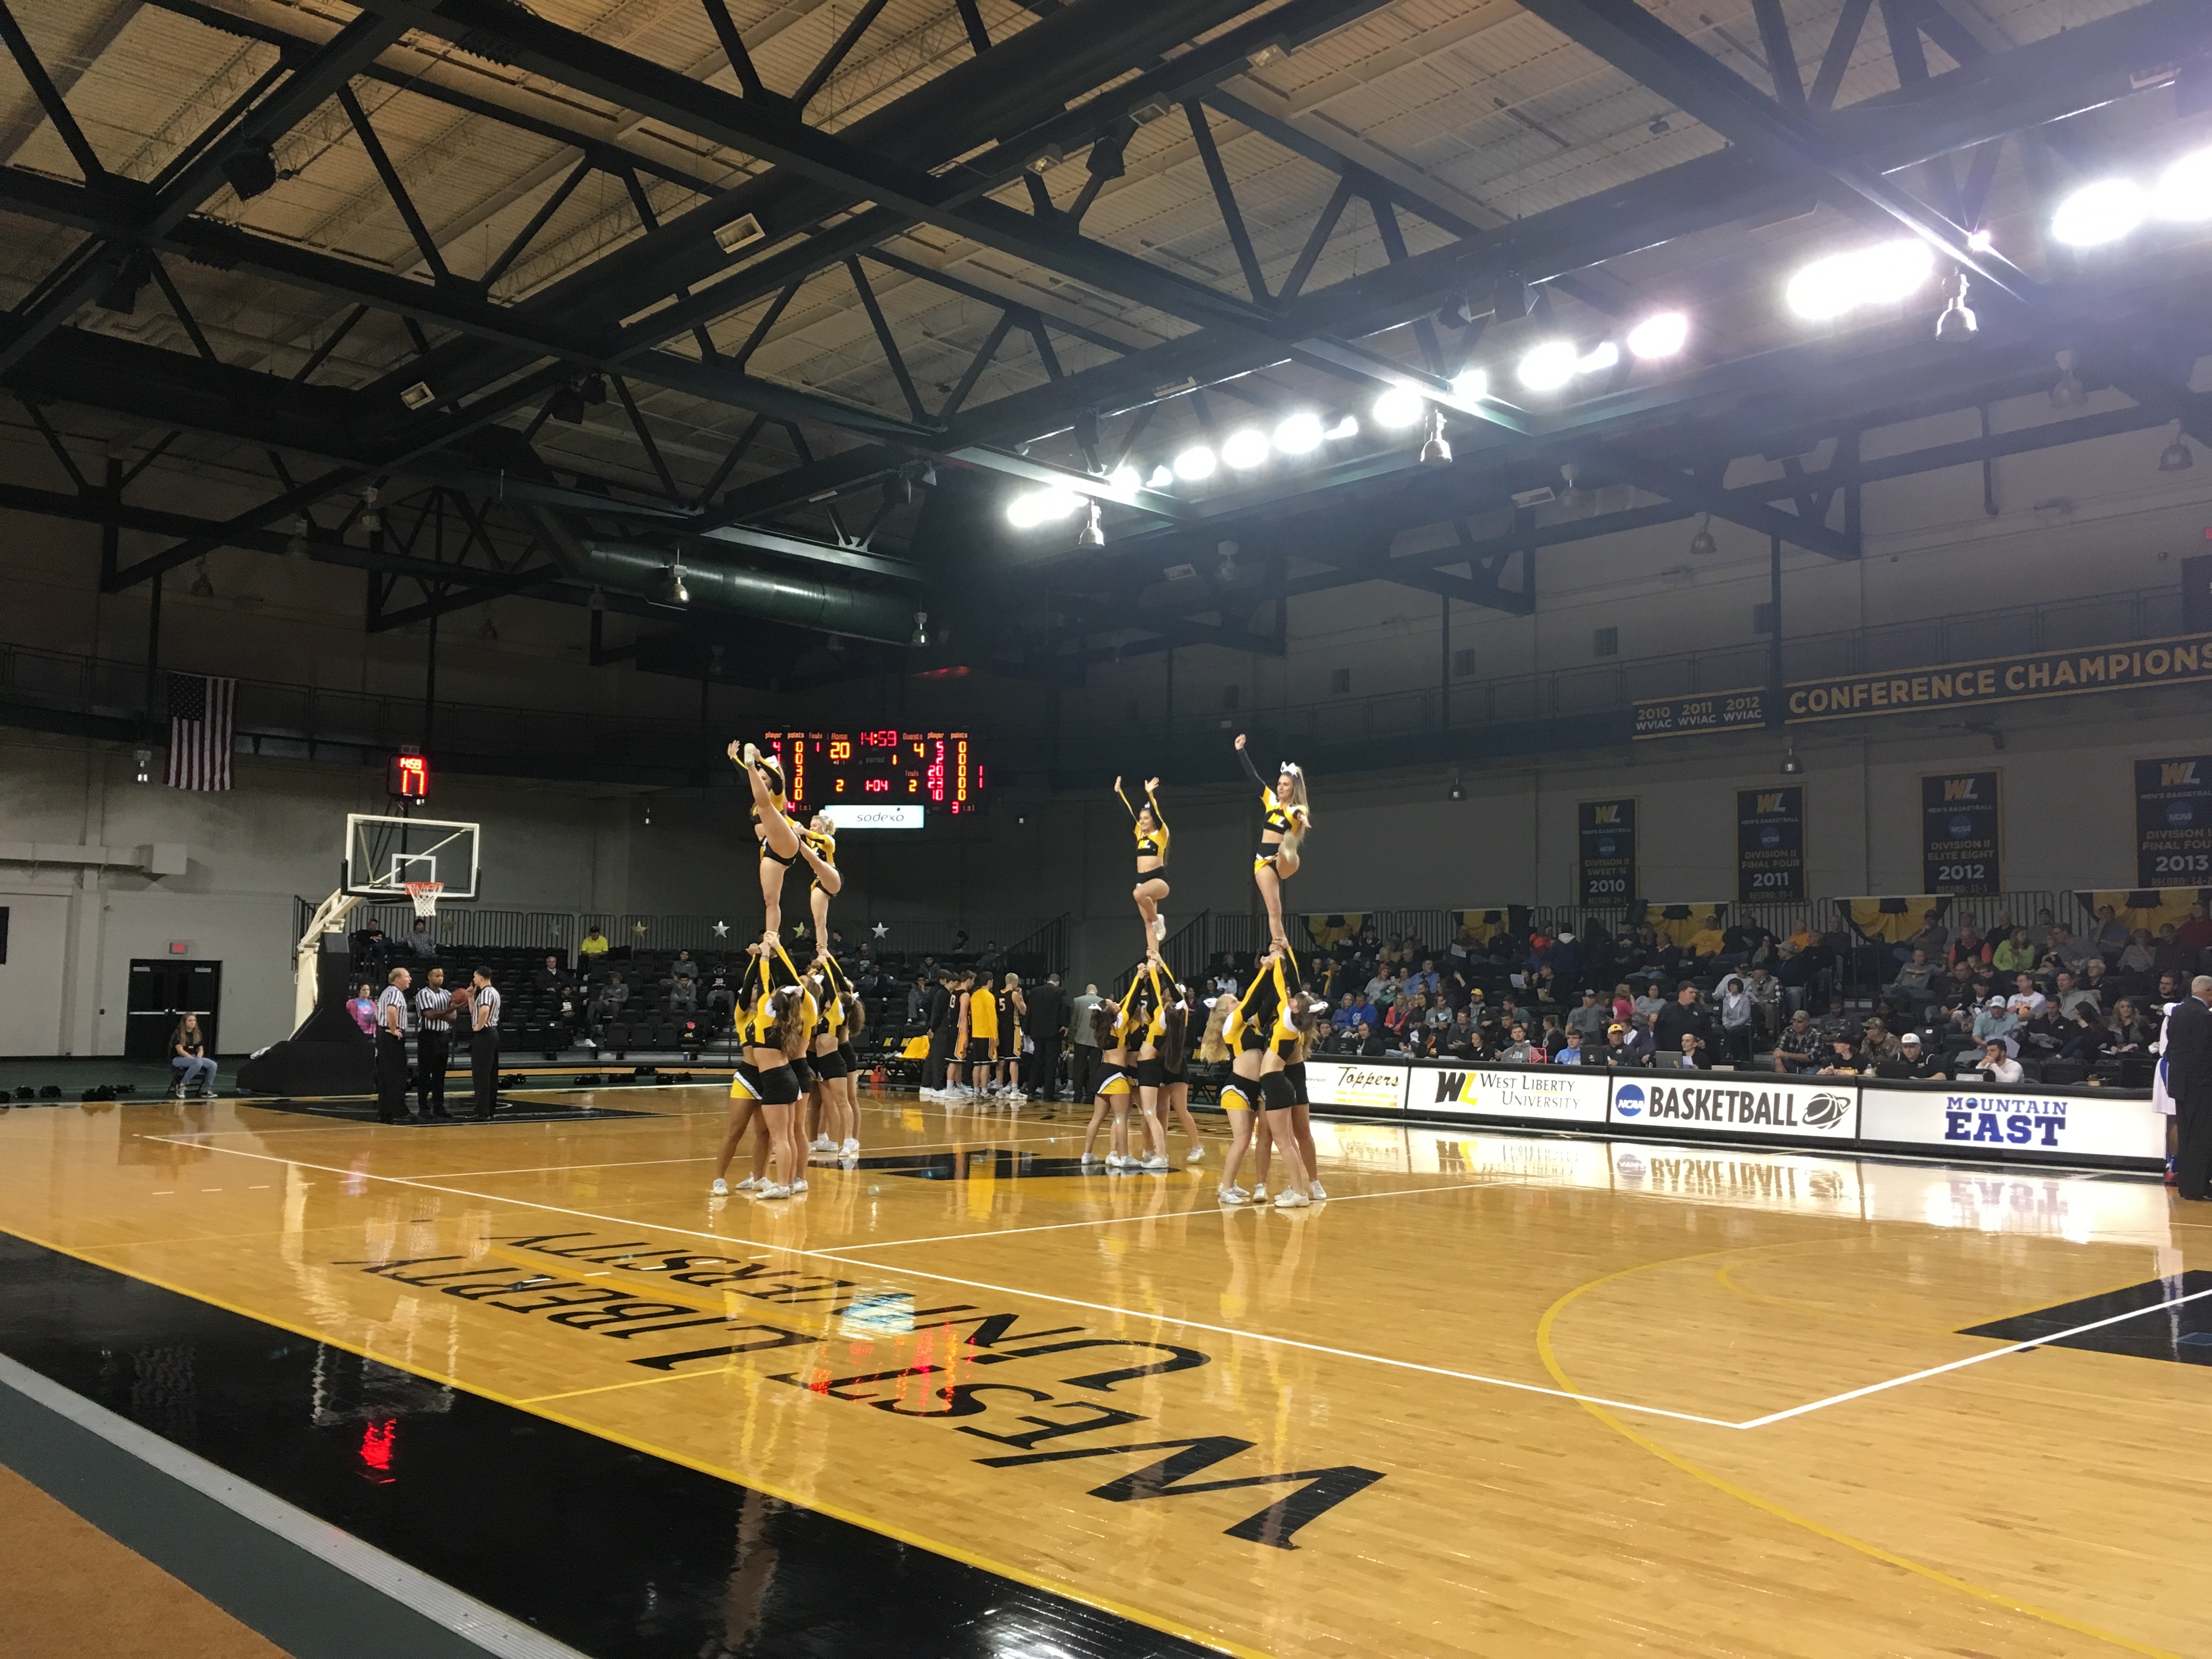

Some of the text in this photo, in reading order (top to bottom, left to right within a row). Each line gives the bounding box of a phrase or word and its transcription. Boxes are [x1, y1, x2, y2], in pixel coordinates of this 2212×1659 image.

[1789, 669, 1995, 714] CONFERENCE
[1681, 702, 1713, 716] 2011
[1725, 696, 1760, 710] 2012
[1638, 707, 1671, 720] 2010
[1678, 714, 1717, 726] WVIAC
[1723, 709, 1762, 722] WVIAC
[1635, 719, 1673, 731] WVIAC
[860, 731, 898, 747] 14:59
[795, 741, 803, 752] 0
[830, 742, 850, 759] 20
[913, 742, 925, 758] 4
[958, 741, 967, 753] 0
[795, 753, 803, 764] 0
[892, 754, 897, 765] 1
[958, 753, 967, 764] 0
[958, 765, 967, 777] 0
[2160, 761, 2200, 786] WL
[402, 770, 424, 795] 17
[794, 777, 803, 788] 0
[835, 778, 845, 792] 2
[908, 779, 918, 792] 2
[958, 777, 967, 788] 0
[794, 789, 803, 800] 0
[957, 789, 967, 801] 0
[1944, 778, 1978, 801] WL
[952, 801, 959, 814] 3
[1757, 793, 1786, 814] WL
[856, 812, 904, 822] sodexo
[1268, 812, 1286, 828] WL
[1595, 805, 1621, 825] WL
[2146, 829, 2204, 839] DIVISION
[1931, 840, 1980, 850] DIVISION
[2142, 839, 2212, 850] FINAL FOU
[1745, 850, 1787, 860] DIVISION
[1928, 849, 1995, 861] ELITE EIGHT
[1584, 858, 1623, 867] DIVISION
[1742, 859, 1800, 870] FINAL FOUR
[2155, 855, 2209, 872] 2013
[1587, 867, 1617, 876] SWEET
[1938, 864, 1984, 880] 2012
[1589, 879, 1626, 893] 2010
[1752, 872, 1789, 887] 2011
[998, 997, 1006, 1012] 5
[1338, 1066, 1400, 1090] Toppers
[1434, 1071, 1479, 1106] WL
[1617, 1099, 1645, 1110] NCAA
[1649, 1086, 1798, 1127] BASKETBALL
[1946, 1096, 2068, 1115] MOUNTAIN
[1945, 1110, 2066, 1147] EAST
[329, 1256, 1387, 1550] WEST LIBERTY
